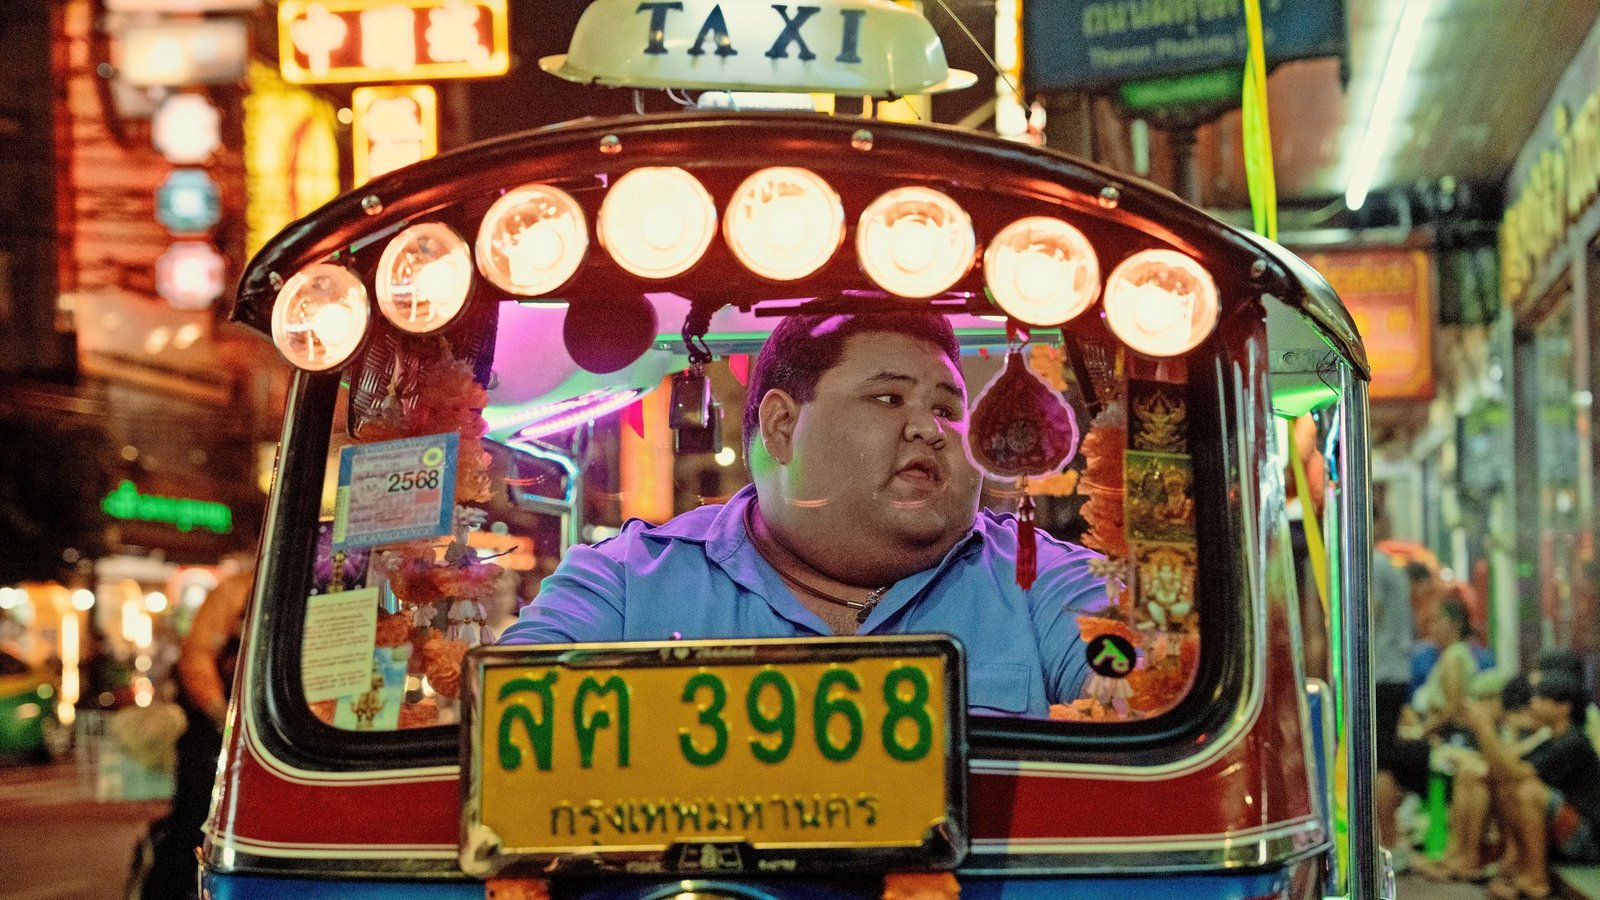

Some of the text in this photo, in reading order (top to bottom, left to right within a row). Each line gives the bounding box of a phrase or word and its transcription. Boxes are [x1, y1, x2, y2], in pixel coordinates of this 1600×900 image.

[636, 1, 866, 63] TAXI
[387, 469, 440, 493] 2568
[679, 665, 933, 767] 3968
[550, 793, 878, 845] กรุงเทพมหานคร
